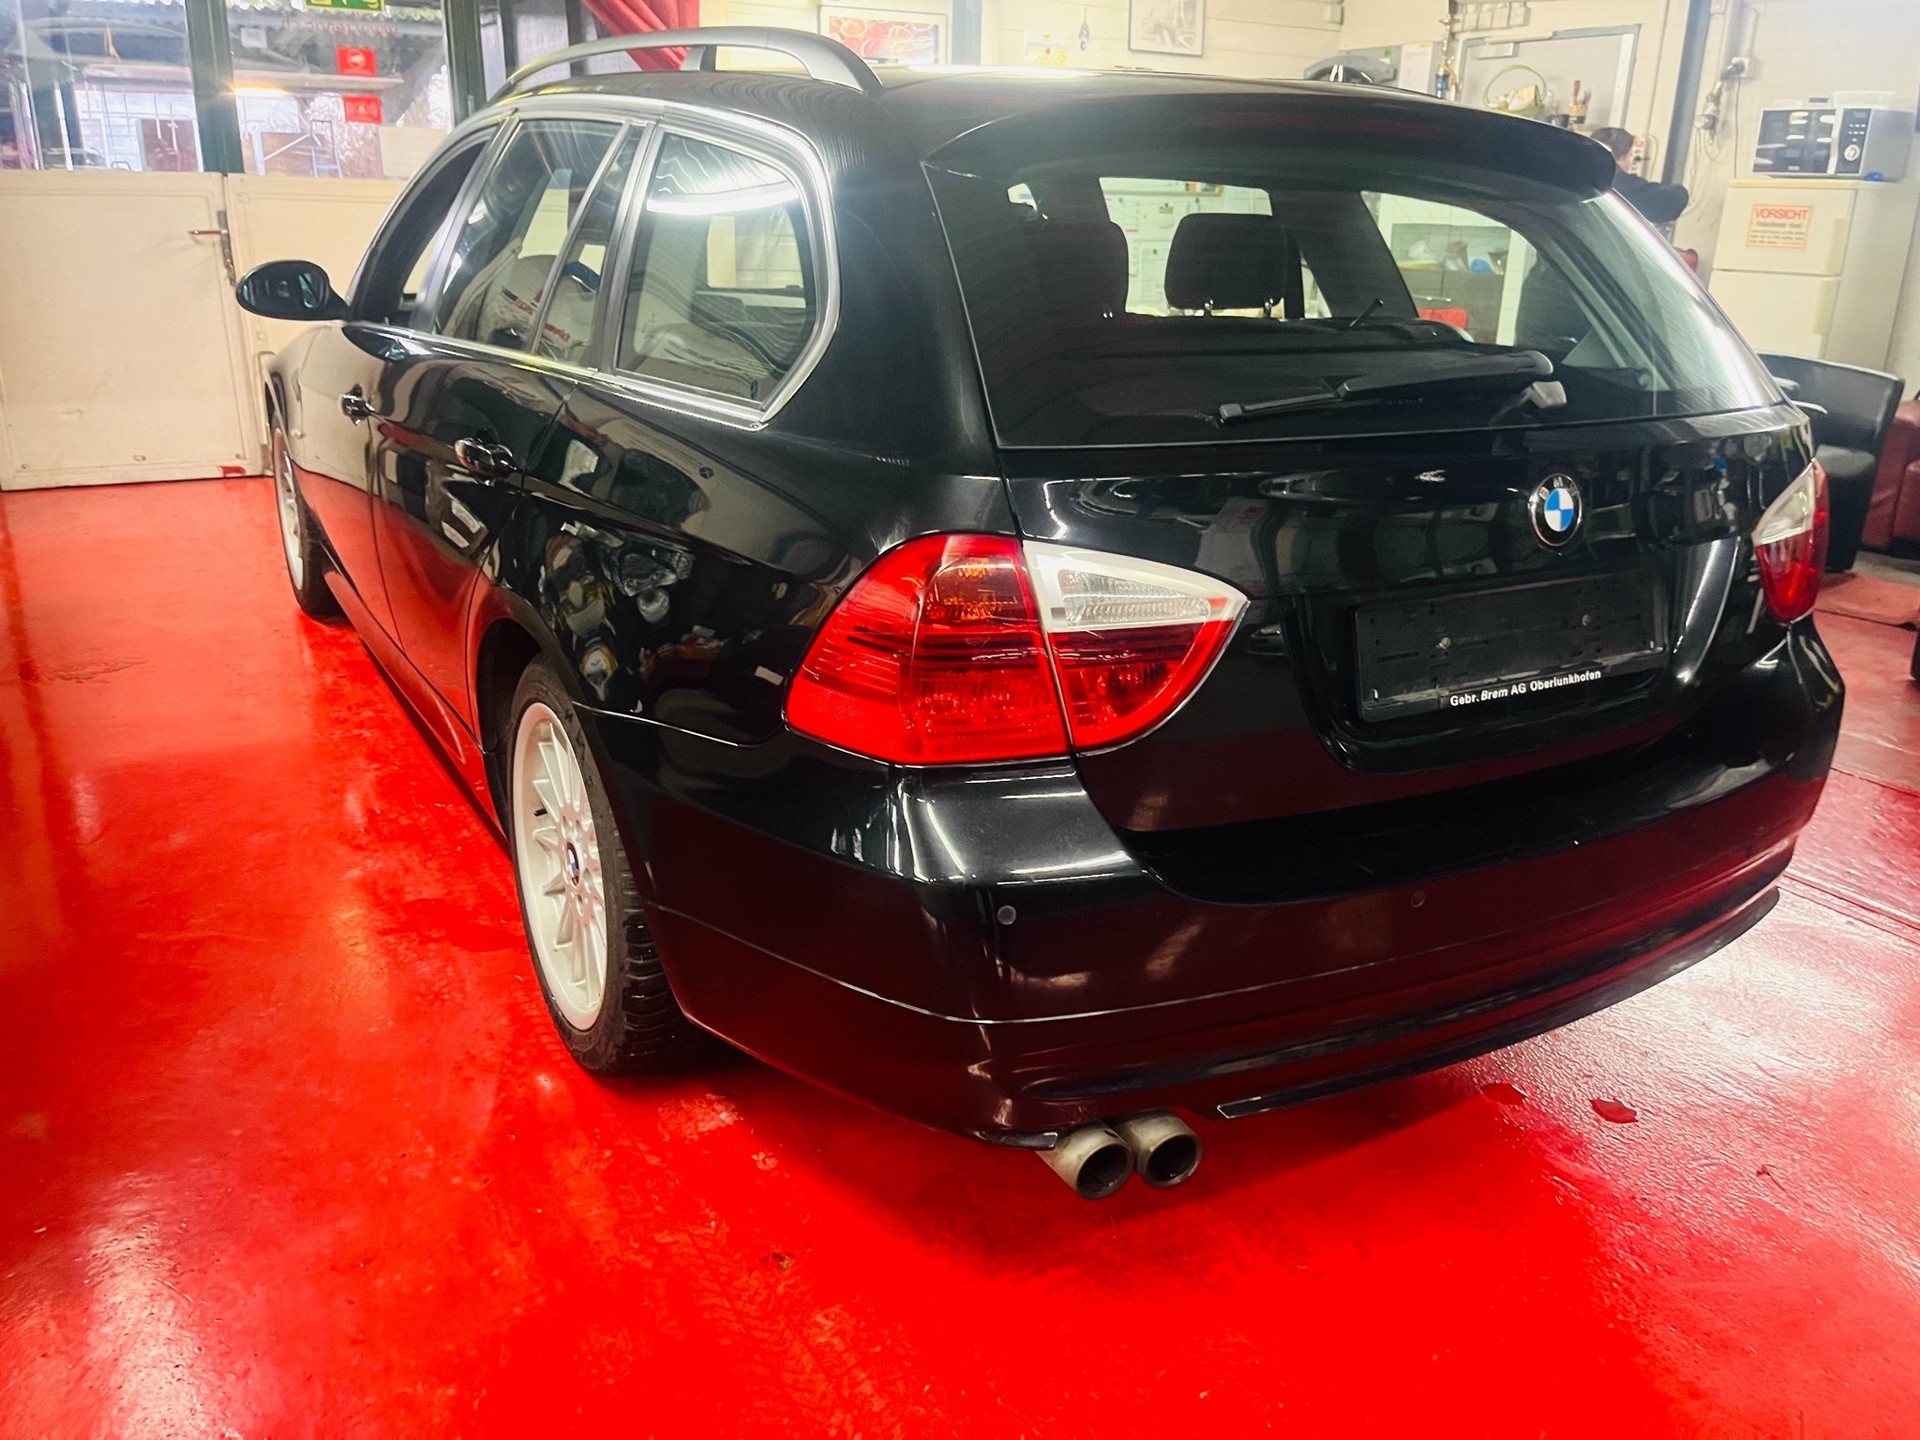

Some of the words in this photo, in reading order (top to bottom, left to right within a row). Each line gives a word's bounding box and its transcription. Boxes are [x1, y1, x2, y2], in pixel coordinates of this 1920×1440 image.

[1755, 208, 1808, 220] VORSICHT
[1450, 694, 1480, 706] Gebr.
[1481, 688, 1508, 701] Brem
[1510, 683, 1527, 695] AG
[1530, 670, 1601, 692] Oberlunkhofen
